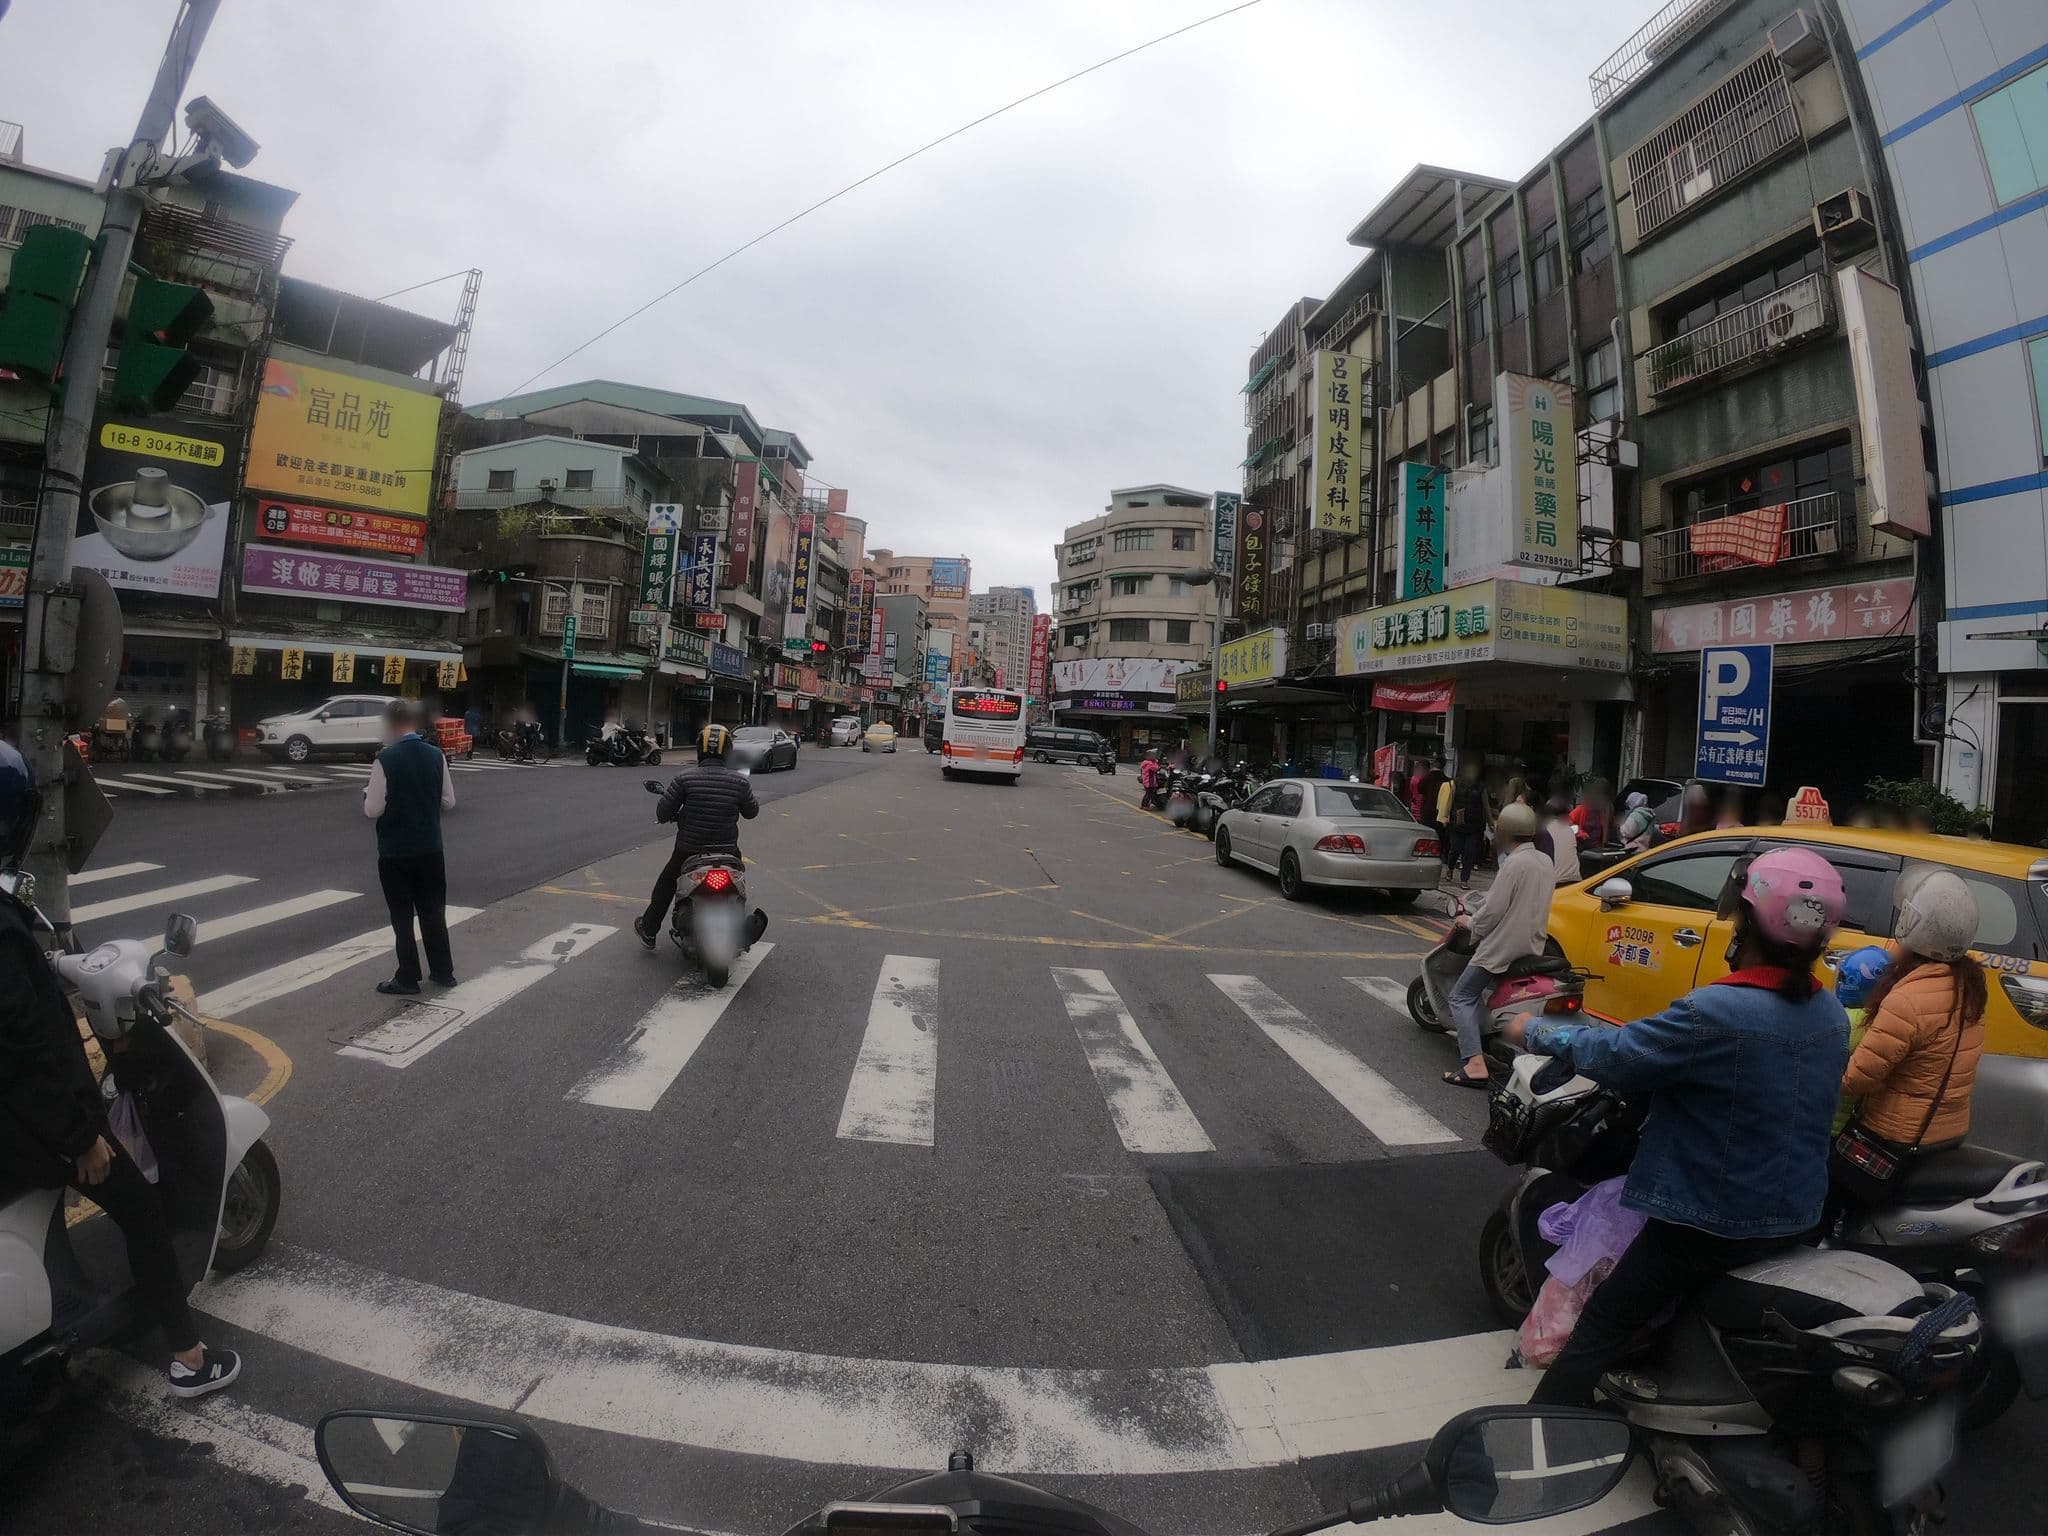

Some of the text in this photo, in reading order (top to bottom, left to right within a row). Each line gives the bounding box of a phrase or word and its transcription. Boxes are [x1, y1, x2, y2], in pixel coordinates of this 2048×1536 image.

[306, 387, 394, 439] 富品苑
[110, 431, 141, 447] 18-8
[276, 452, 407, 489] 歡迎危老都更重建諮詢
[334, 480, 383, 497] 2391-9888
[1323, 511, 1353, 527] 診所
[1519, 551, 1573, 569] 02 29788120
[324, 572, 398, 596] 美學殿堂
[1371, 604, 1487, 649] 陽光藥師 藥局
[283, 649, 300, 679] 半價
[336, 652, 351, 681] 半價
[385, 656, 402, 684] 半價
[440, 660, 457, 688] 半價
[1704, 650, 1751, 721] P
[1698, 745, 1765, 767] 公有正義停車場
[1805, 791, 1819, 804] M
[1795, 805, 1828, 820] 55178
[1624, 926, 1655, 944] 52098
[1612, 941, 1651, 966] 大都會
